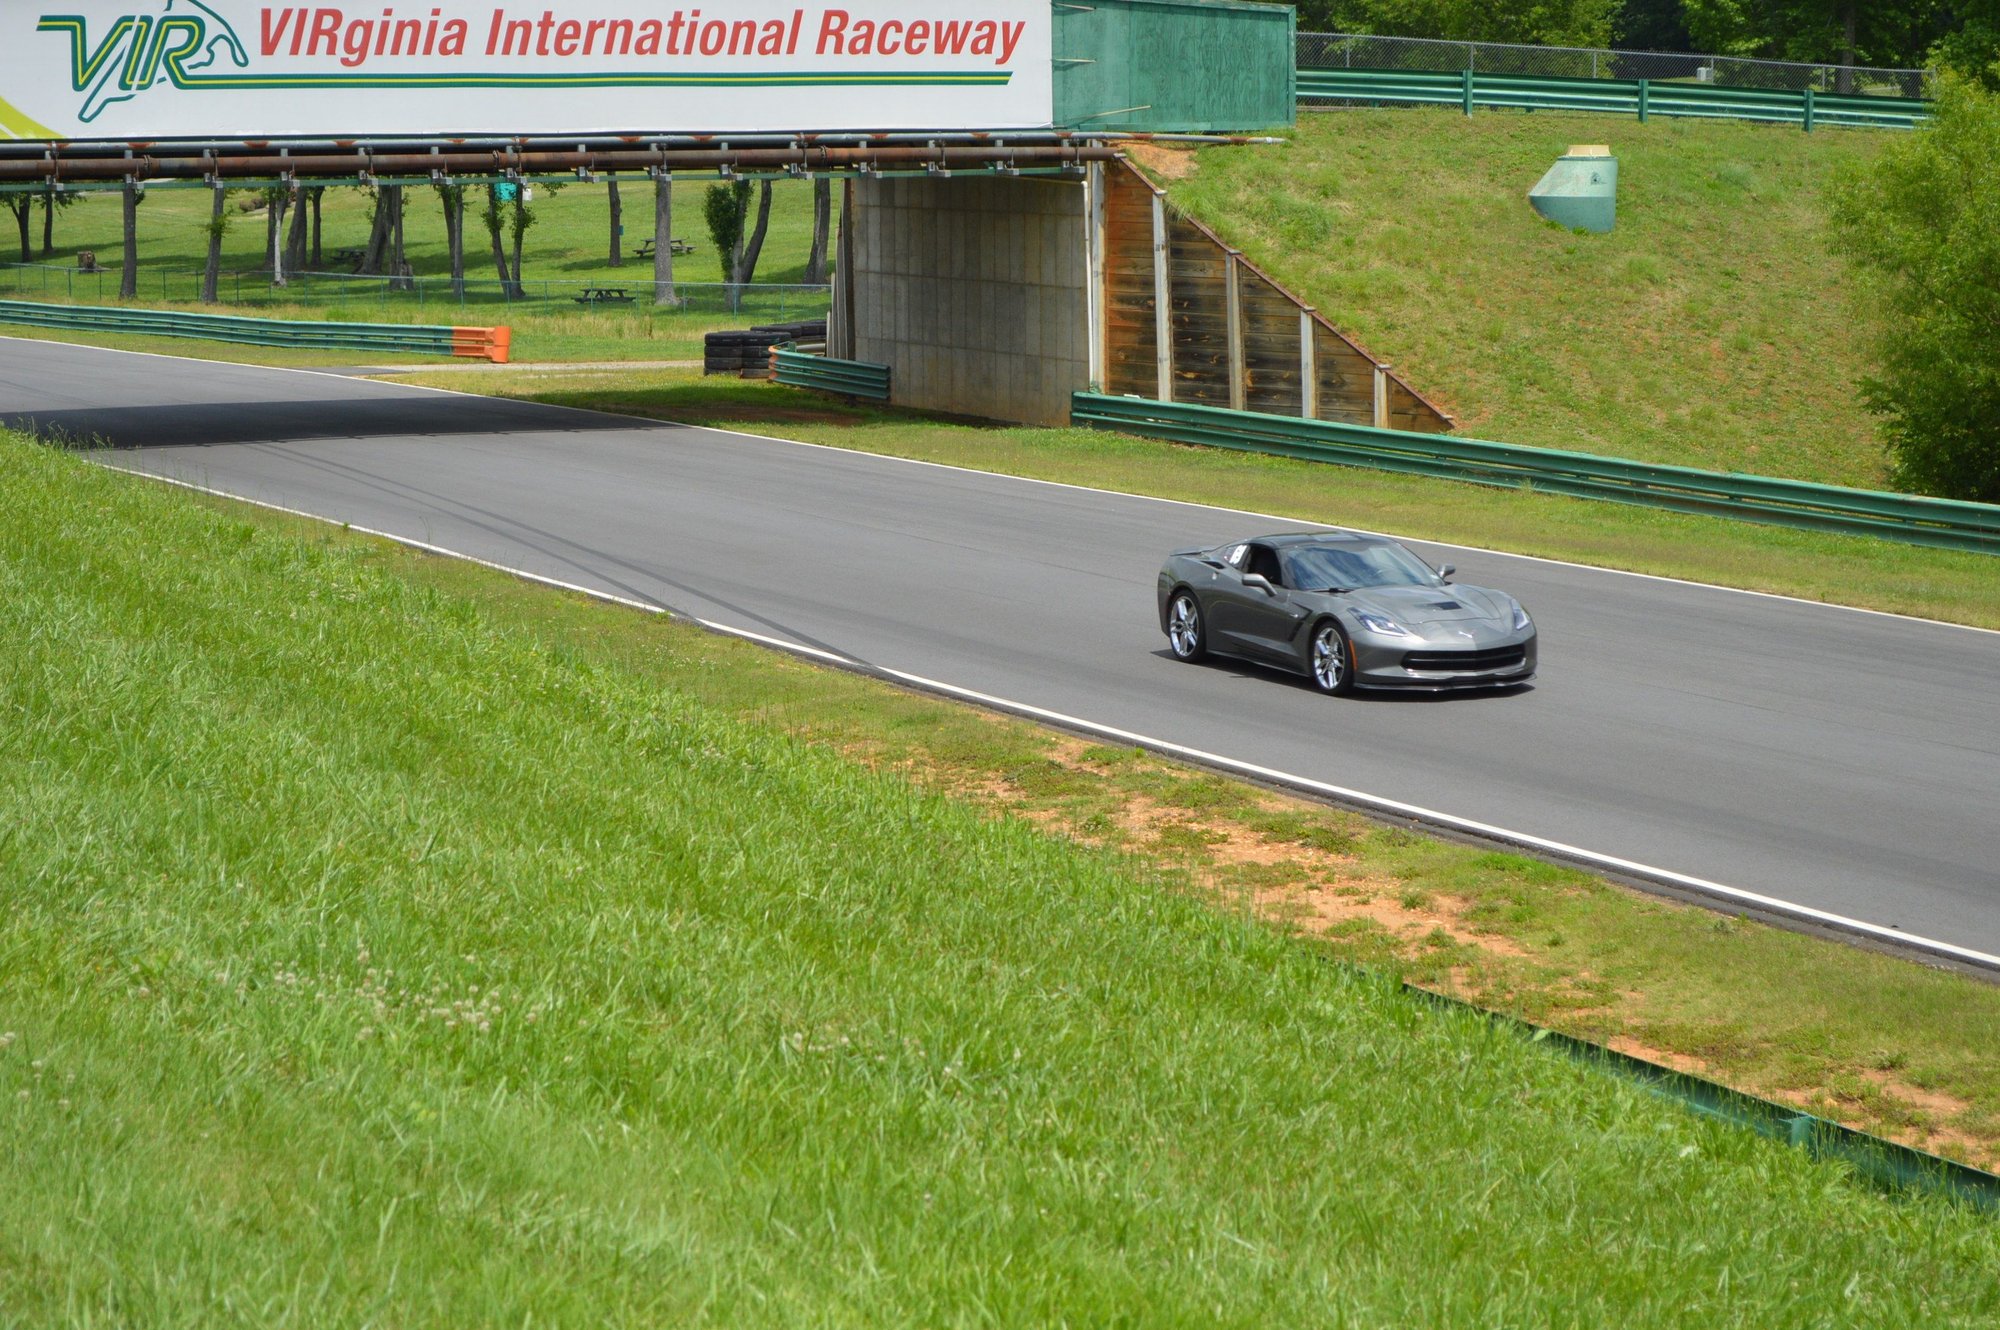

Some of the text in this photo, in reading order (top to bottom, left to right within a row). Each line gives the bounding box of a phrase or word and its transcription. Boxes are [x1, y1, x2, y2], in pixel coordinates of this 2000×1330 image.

[37, 15, 205, 91] VIR
[261, 8, 1026, 67] VIRginia International Raceway
